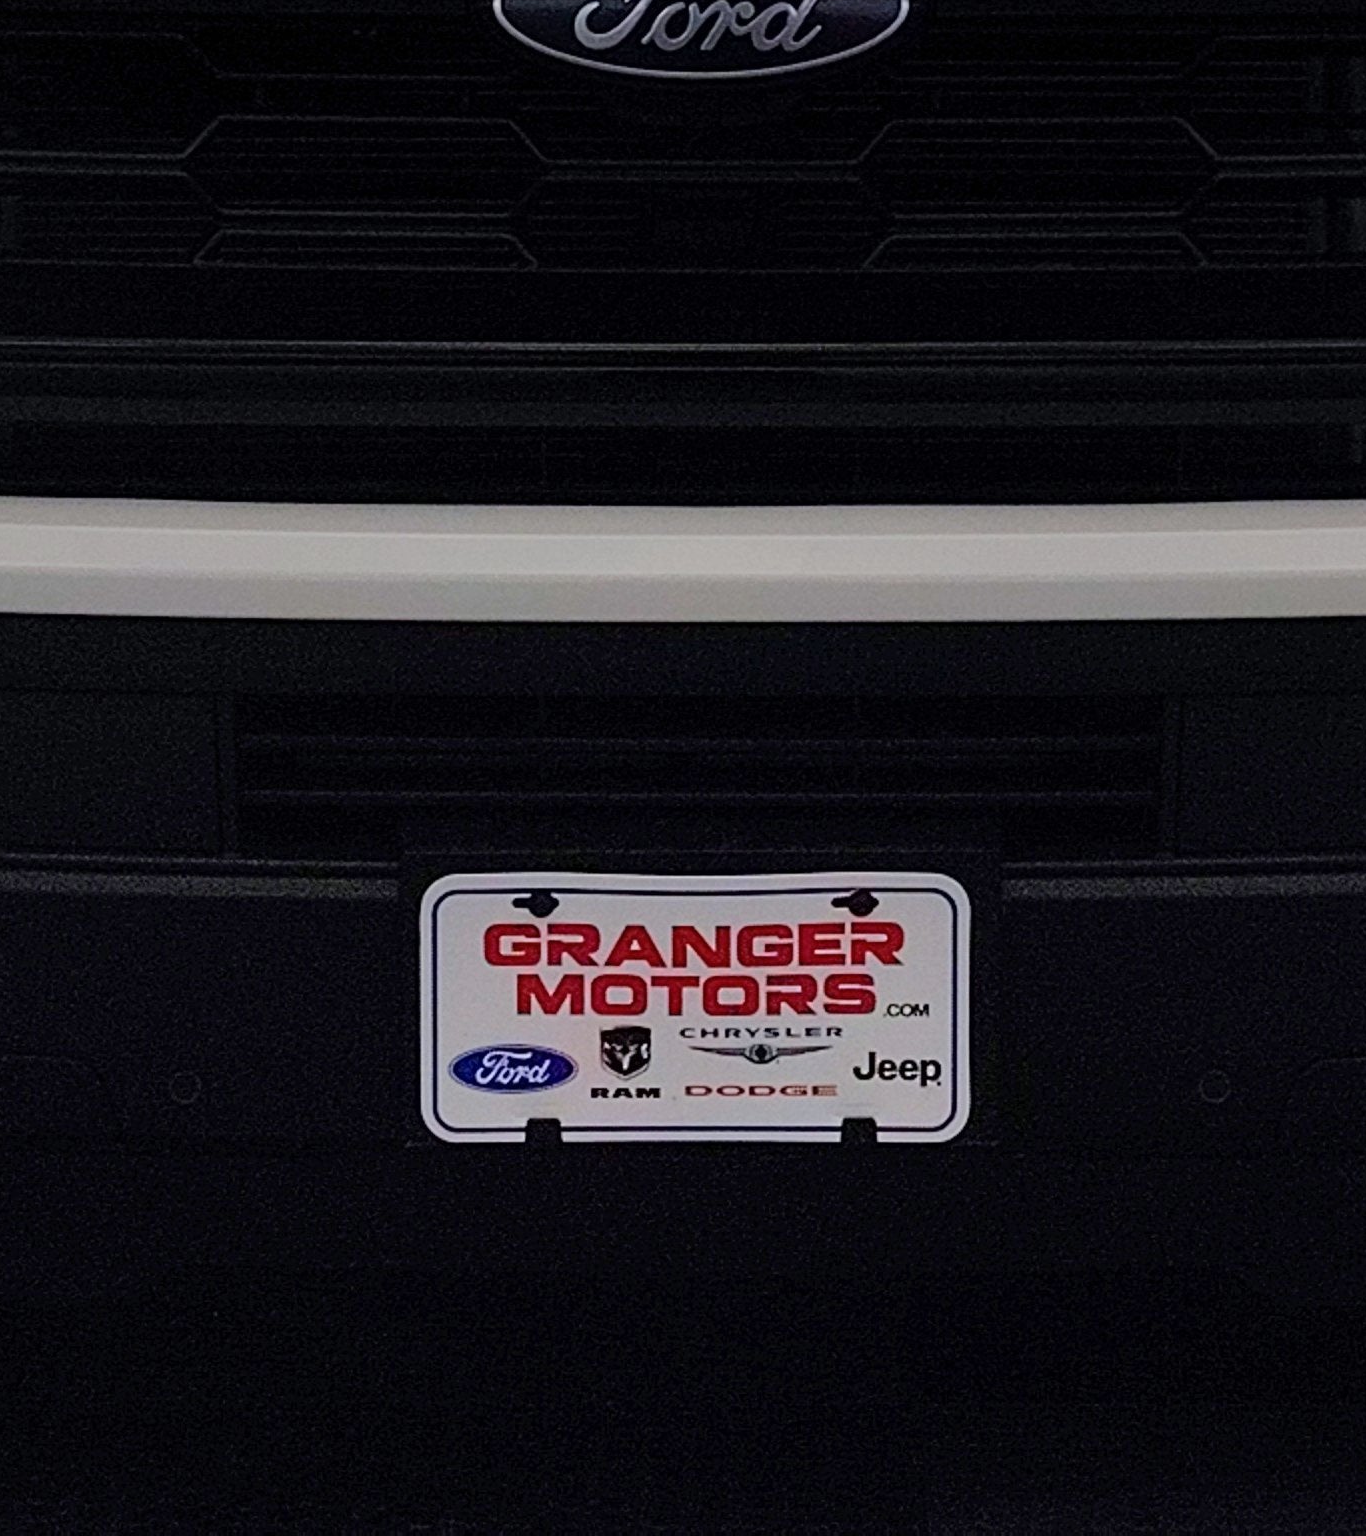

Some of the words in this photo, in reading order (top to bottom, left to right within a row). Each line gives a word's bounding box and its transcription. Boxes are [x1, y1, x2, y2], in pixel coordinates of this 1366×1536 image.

[483, 922, 905, 969] GRANGER
[516, 973, 877, 1016] MOTORS
[882, 1003, 930, 1018] .COM
[679, 1027, 843, 1039] CHRYSLER
[475, 1051, 550, 1085] Ford
[852, 1052, 942, 1087] Jeep
[590, 1087, 661, 1099] RAM
[684, 1085, 838, 1097] DODGE
